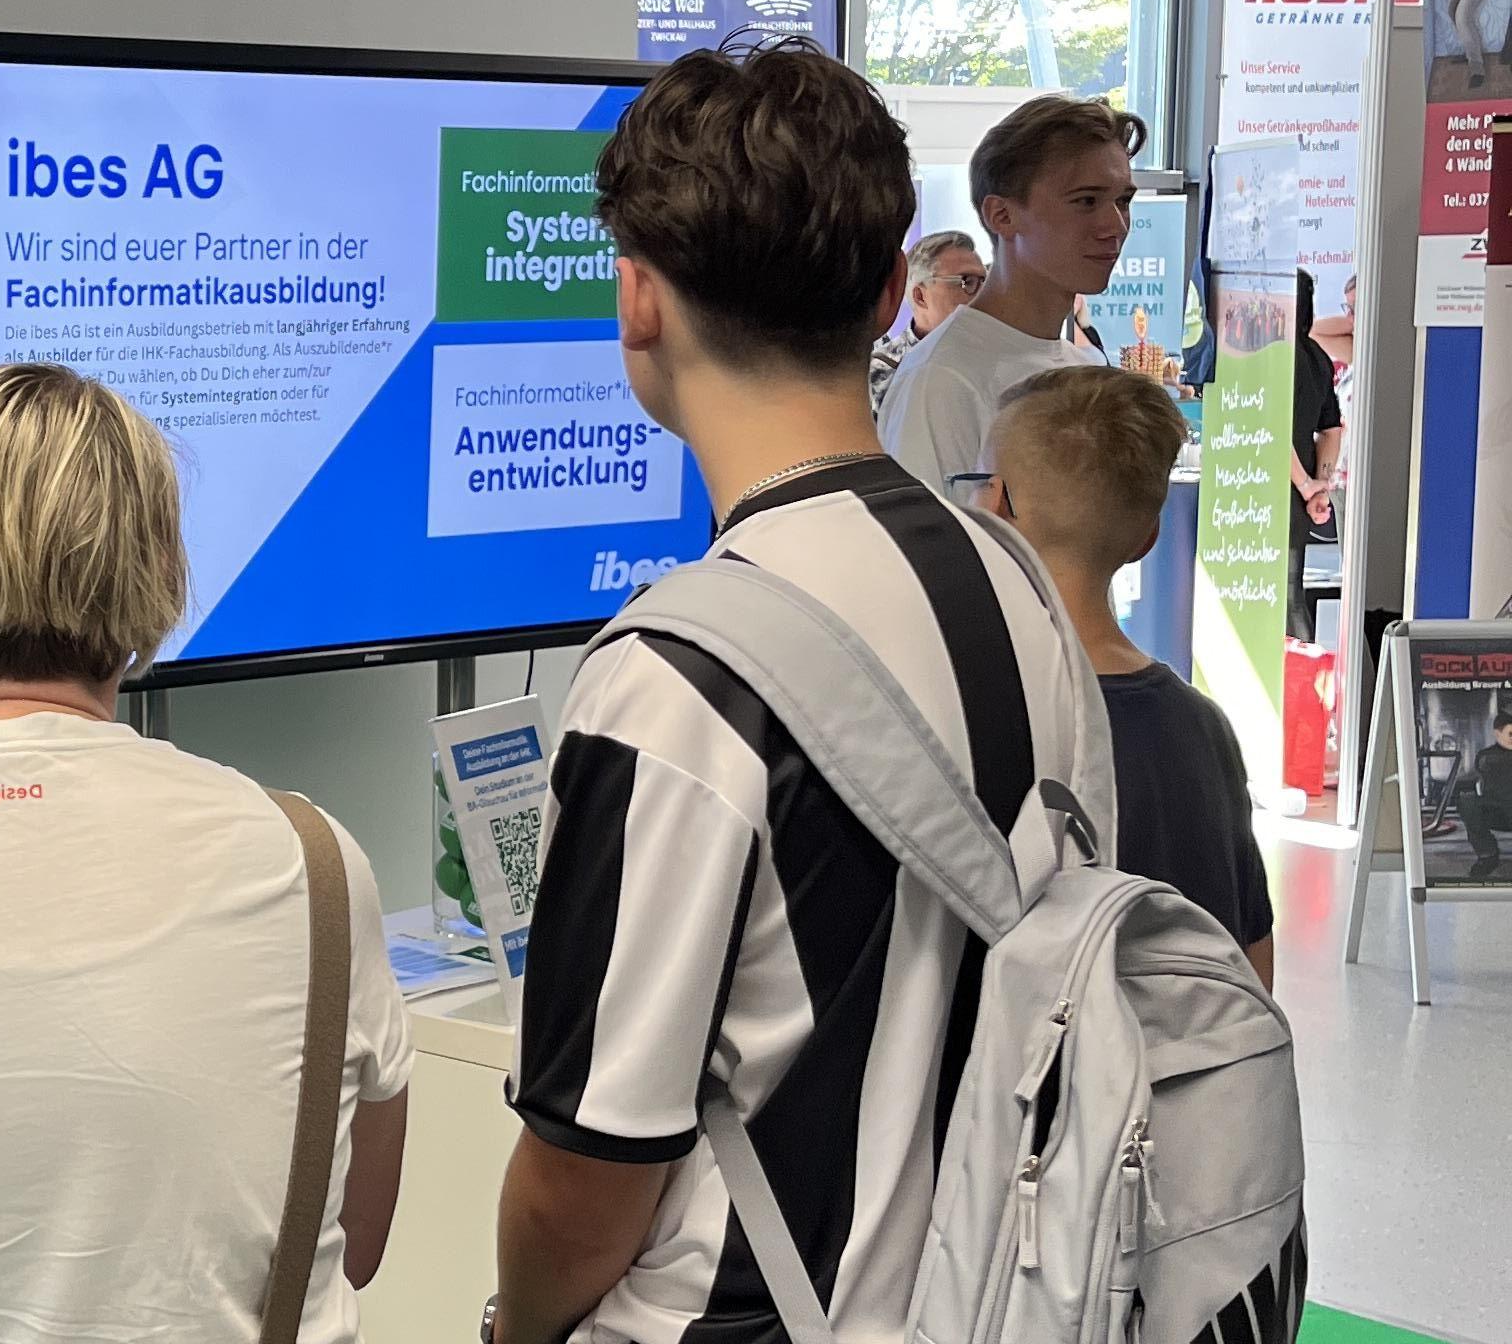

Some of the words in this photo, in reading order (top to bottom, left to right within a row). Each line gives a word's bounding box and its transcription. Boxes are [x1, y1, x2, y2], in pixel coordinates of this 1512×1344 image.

[1255, 10, 1345, 24] GETRÄNKE
[1241, 60, 1265, 75] Unser
[1267, 60, 1301, 75] Service
[1287, 81, 1303, 94] und
[1238, 120, 1266, 134] Unser
[1448, 114, 1480, 131] Mehr
[1446, 135, 1470, 152] den
[8, 137, 128, 199] ibes
[142, 143, 224, 200] AG
[1445, 158, 1454, 172] 4
[1327, 176, 1346, 189] und
[1443, 193, 1467, 207] Tel.:
[5, 232, 53, 262] Wir
[60, 232, 117, 262] sind
[124, 237, 188, 262] euer
[195, 232, 292, 261] Partner
[298, 232, 320, 260] in
[326, 232, 369, 260] der
[1470, 237, 1488, 251] Z
[485, 245, 620, 292] integrati
[6, 275, 387, 309] Fachinformatikausbildung!
[1108, 283, 1143, 297] MM
[1147, 283, 1164, 297] IN
[5, 325, 28, 340] Die
[30, 324, 58, 340] ibes
[61, 324, 81, 339] AG
[84, 323, 101, 338] ist
[103, 323, 124, 338] ein
[126, 320, 251, 340] Ausbildungsbetrieb
[253, 320, 275, 335] mit
[276, 318, 349, 337] langjähriger
[352, 318, 411, 335] Erfahrung
[5, 348, 24, 363] als
[28, 347, 92, 363] Ausbilder
[95, 346, 114, 361] für
[118, 346, 138, 361] die
[272, 342, 292, 356] Als
[107, 370, 125, 385] Du
[128, 368, 178, 385] wählen,
[180, 367, 198, 382] ob
[201, 366, 219, 381] Du
[221, 366, 250, 381] Dich
[252, 364, 281, 380] eher
[282, 363, 332, 379] zum/zur
[139, 391, 158, 406] für
[161, 387, 278, 407] Systemintegration
[280, 385, 309, 401] oder
[311, 383, 330, 400] für
[173, 410, 257, 429] spezialisieren
[260, 408, 321, 424] möchtest.
[454, 419, 663, 457] Anwendungs-
[468, 455, 648, 493] entwicklung
